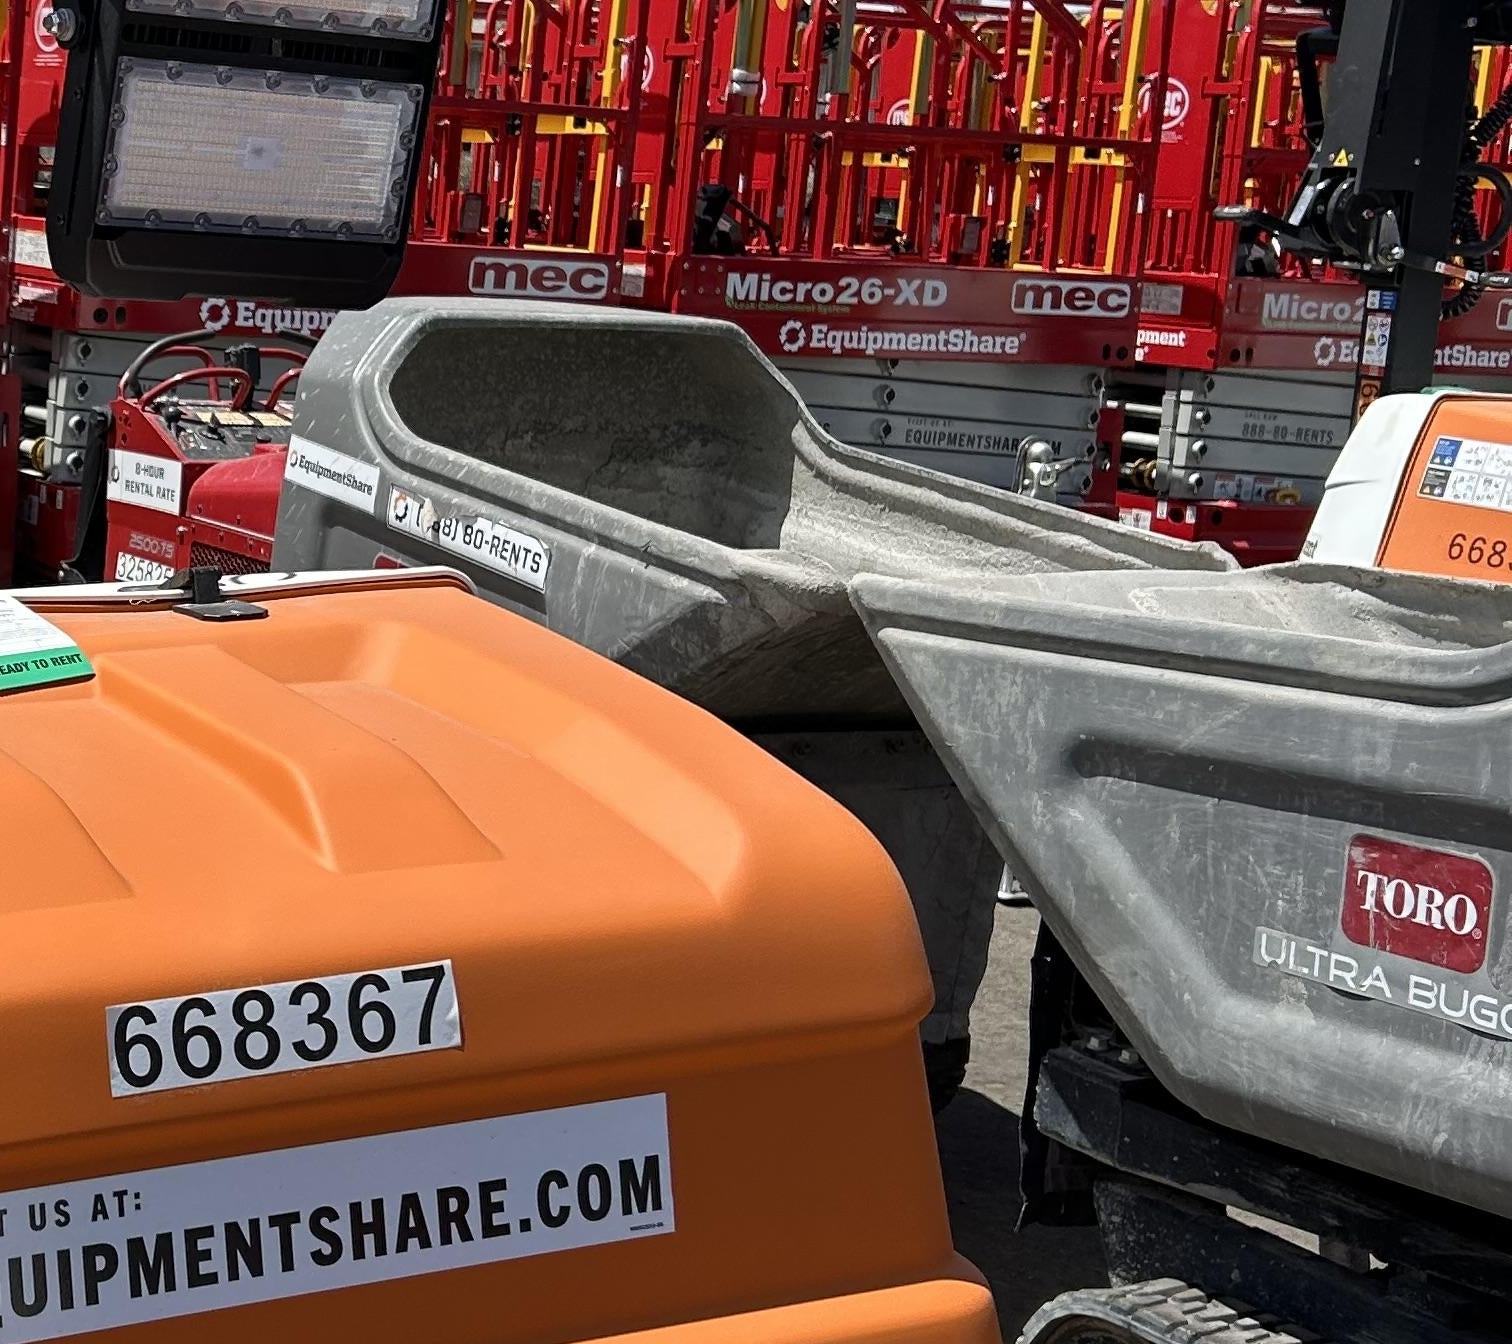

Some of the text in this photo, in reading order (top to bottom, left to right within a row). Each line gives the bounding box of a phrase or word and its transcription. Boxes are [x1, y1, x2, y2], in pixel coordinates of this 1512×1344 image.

[472, 261, 606, 295] mec
[1015, 284, 1128, 314] mec
[810, 324, 1019, 355] EquipmentShare
[124, 479, 176, 503] RENTAL RATE
[298, 454, 373, 496] EquipmentShare
[462, 525, 542, 574] 80-RENTS
[1448, 532, 1512, 572] 668
[31, 657, 50, 671] TO
[51, 653, 84, 667] RENT
[1356, 869, 1478, 936] TORO
[1260, 932, 1512, 1034] ULTRA BUG
[112, 966, 447, 1088] 668367
[28, 1197, 71, 1232] US
[90, 1188, 143, 1223] AT:
